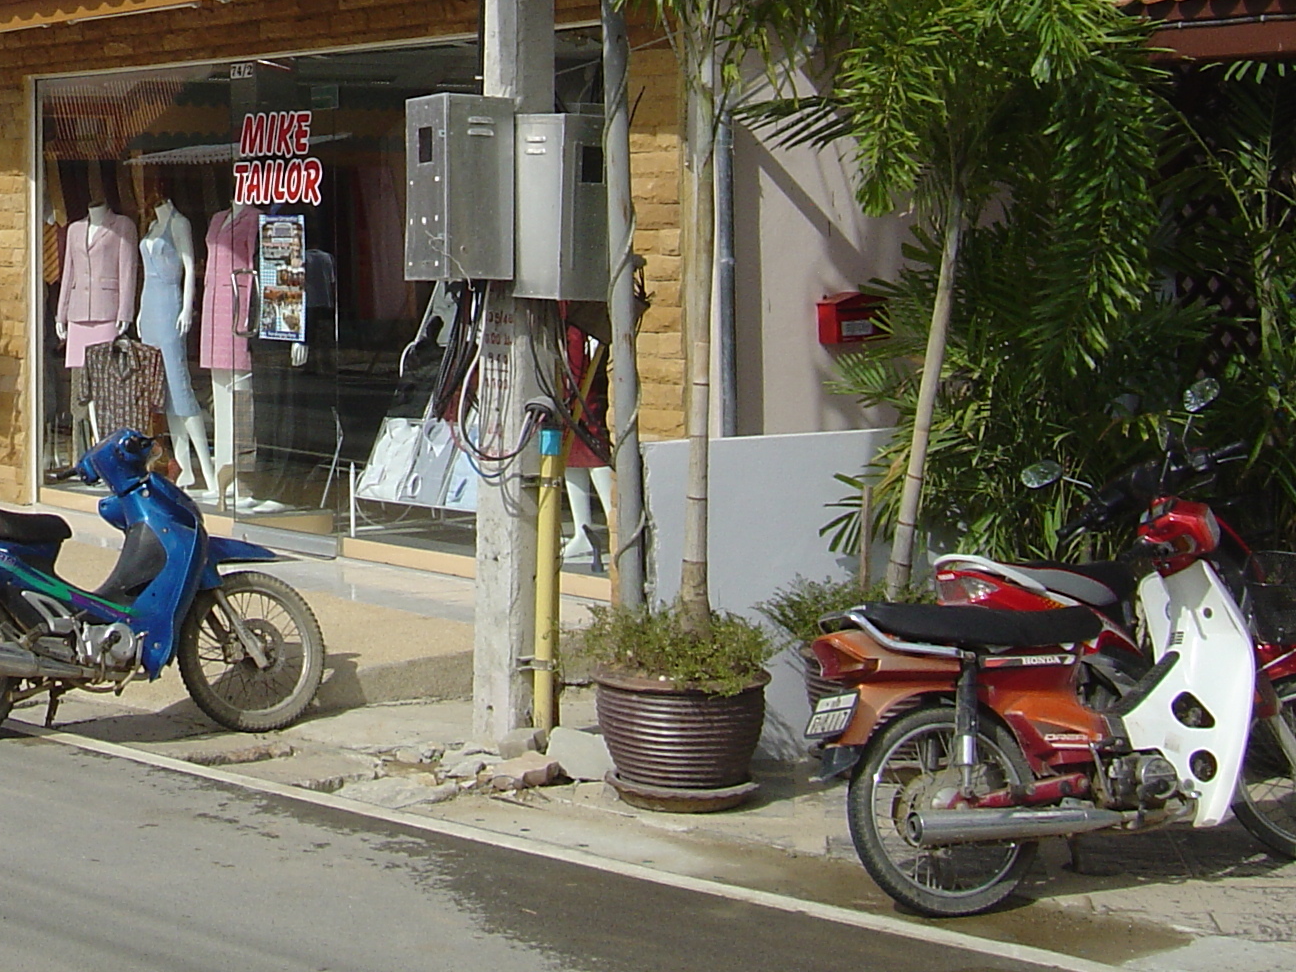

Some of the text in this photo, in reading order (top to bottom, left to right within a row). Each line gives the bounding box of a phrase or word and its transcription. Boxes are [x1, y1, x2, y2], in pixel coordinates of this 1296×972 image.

[240, 110, 312, 158] MIKE
[233, 157, 322, 206] TAILOR
[1021, 656, 1062, 666] HONDA
